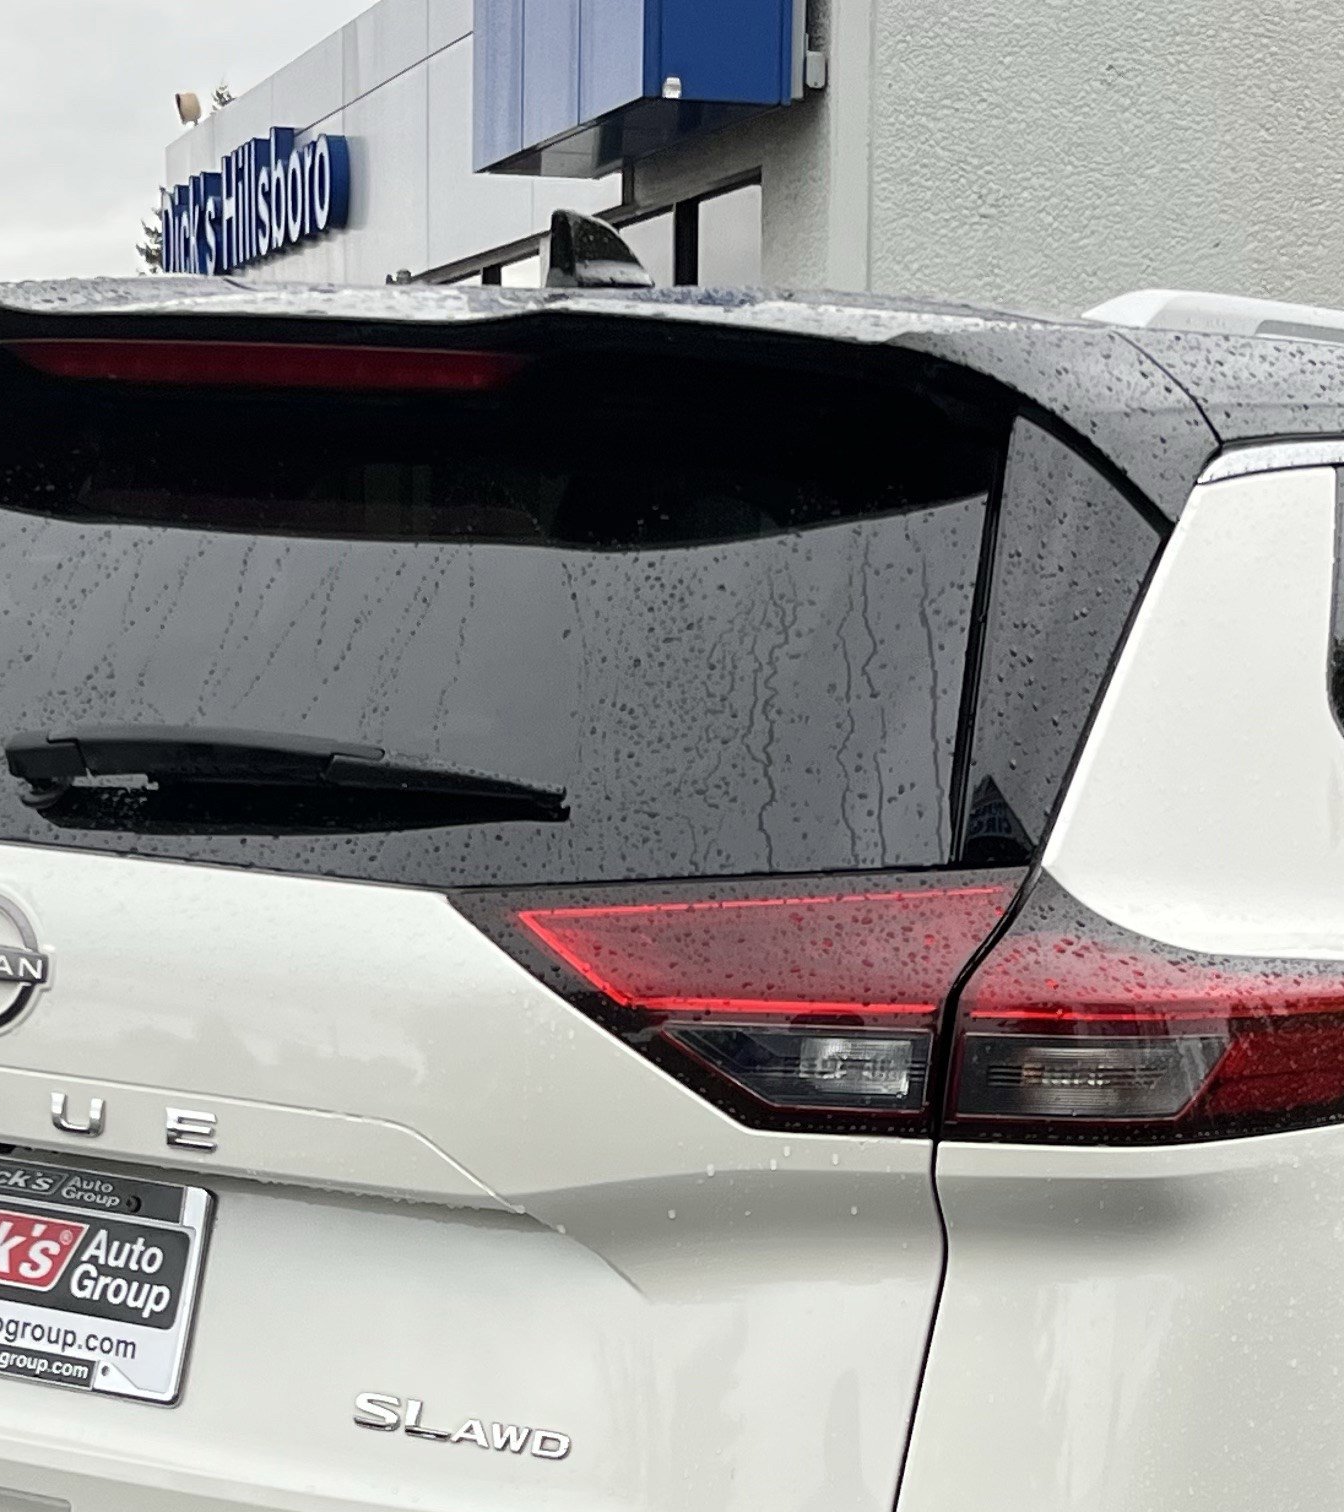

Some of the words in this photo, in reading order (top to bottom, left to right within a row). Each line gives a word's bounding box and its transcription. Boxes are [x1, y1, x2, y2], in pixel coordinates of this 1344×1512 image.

[222, 126, 332, 271] Hillsboro
[61, 1185, 120, 1209] Group
[69, 1175, 114, 1194] Auto
[80, 1230, 164, 1274] Auto
[69, 1262, 172, 1319] Group
[354, 1391, 450, 1442] SL
[450, 1418, 572, 1461] AWD
